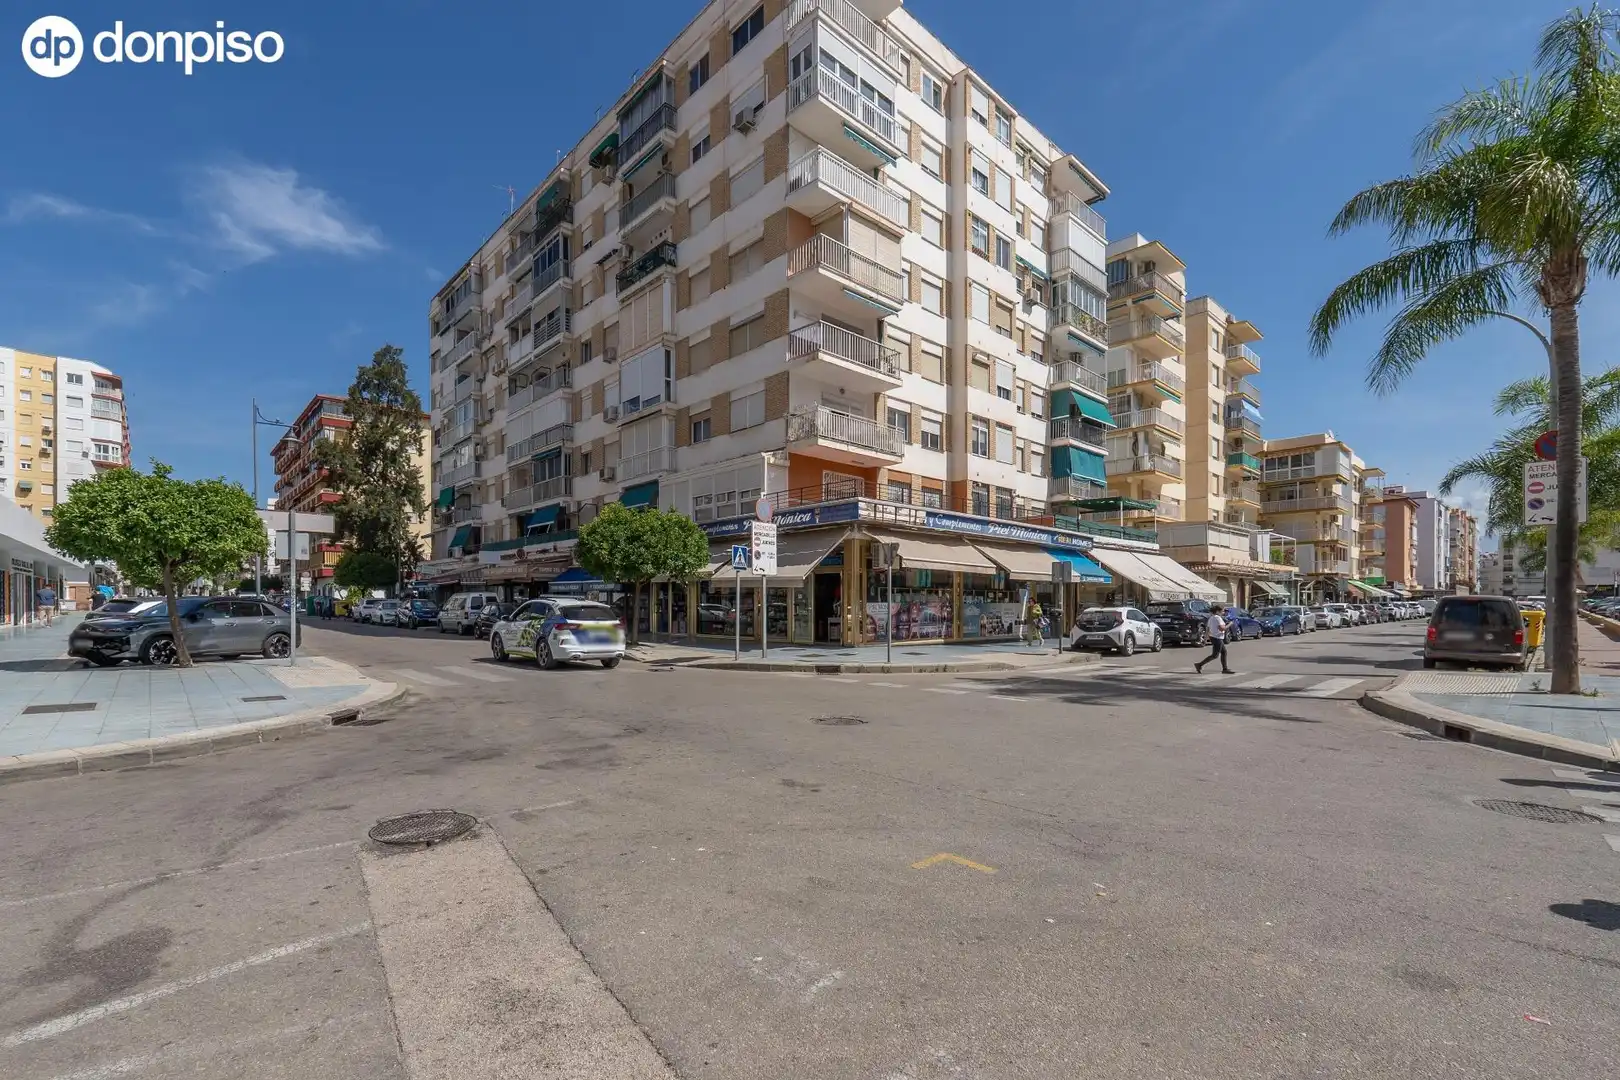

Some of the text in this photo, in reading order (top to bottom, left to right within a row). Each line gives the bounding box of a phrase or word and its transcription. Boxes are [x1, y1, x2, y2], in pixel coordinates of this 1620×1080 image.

[935, 514, 982, 531] Complementos
[987, 522, 1010, 535] Piel
[1010, 525, 1048, 541] Mónica
[1072, 537, 1093, 548] HOMES
